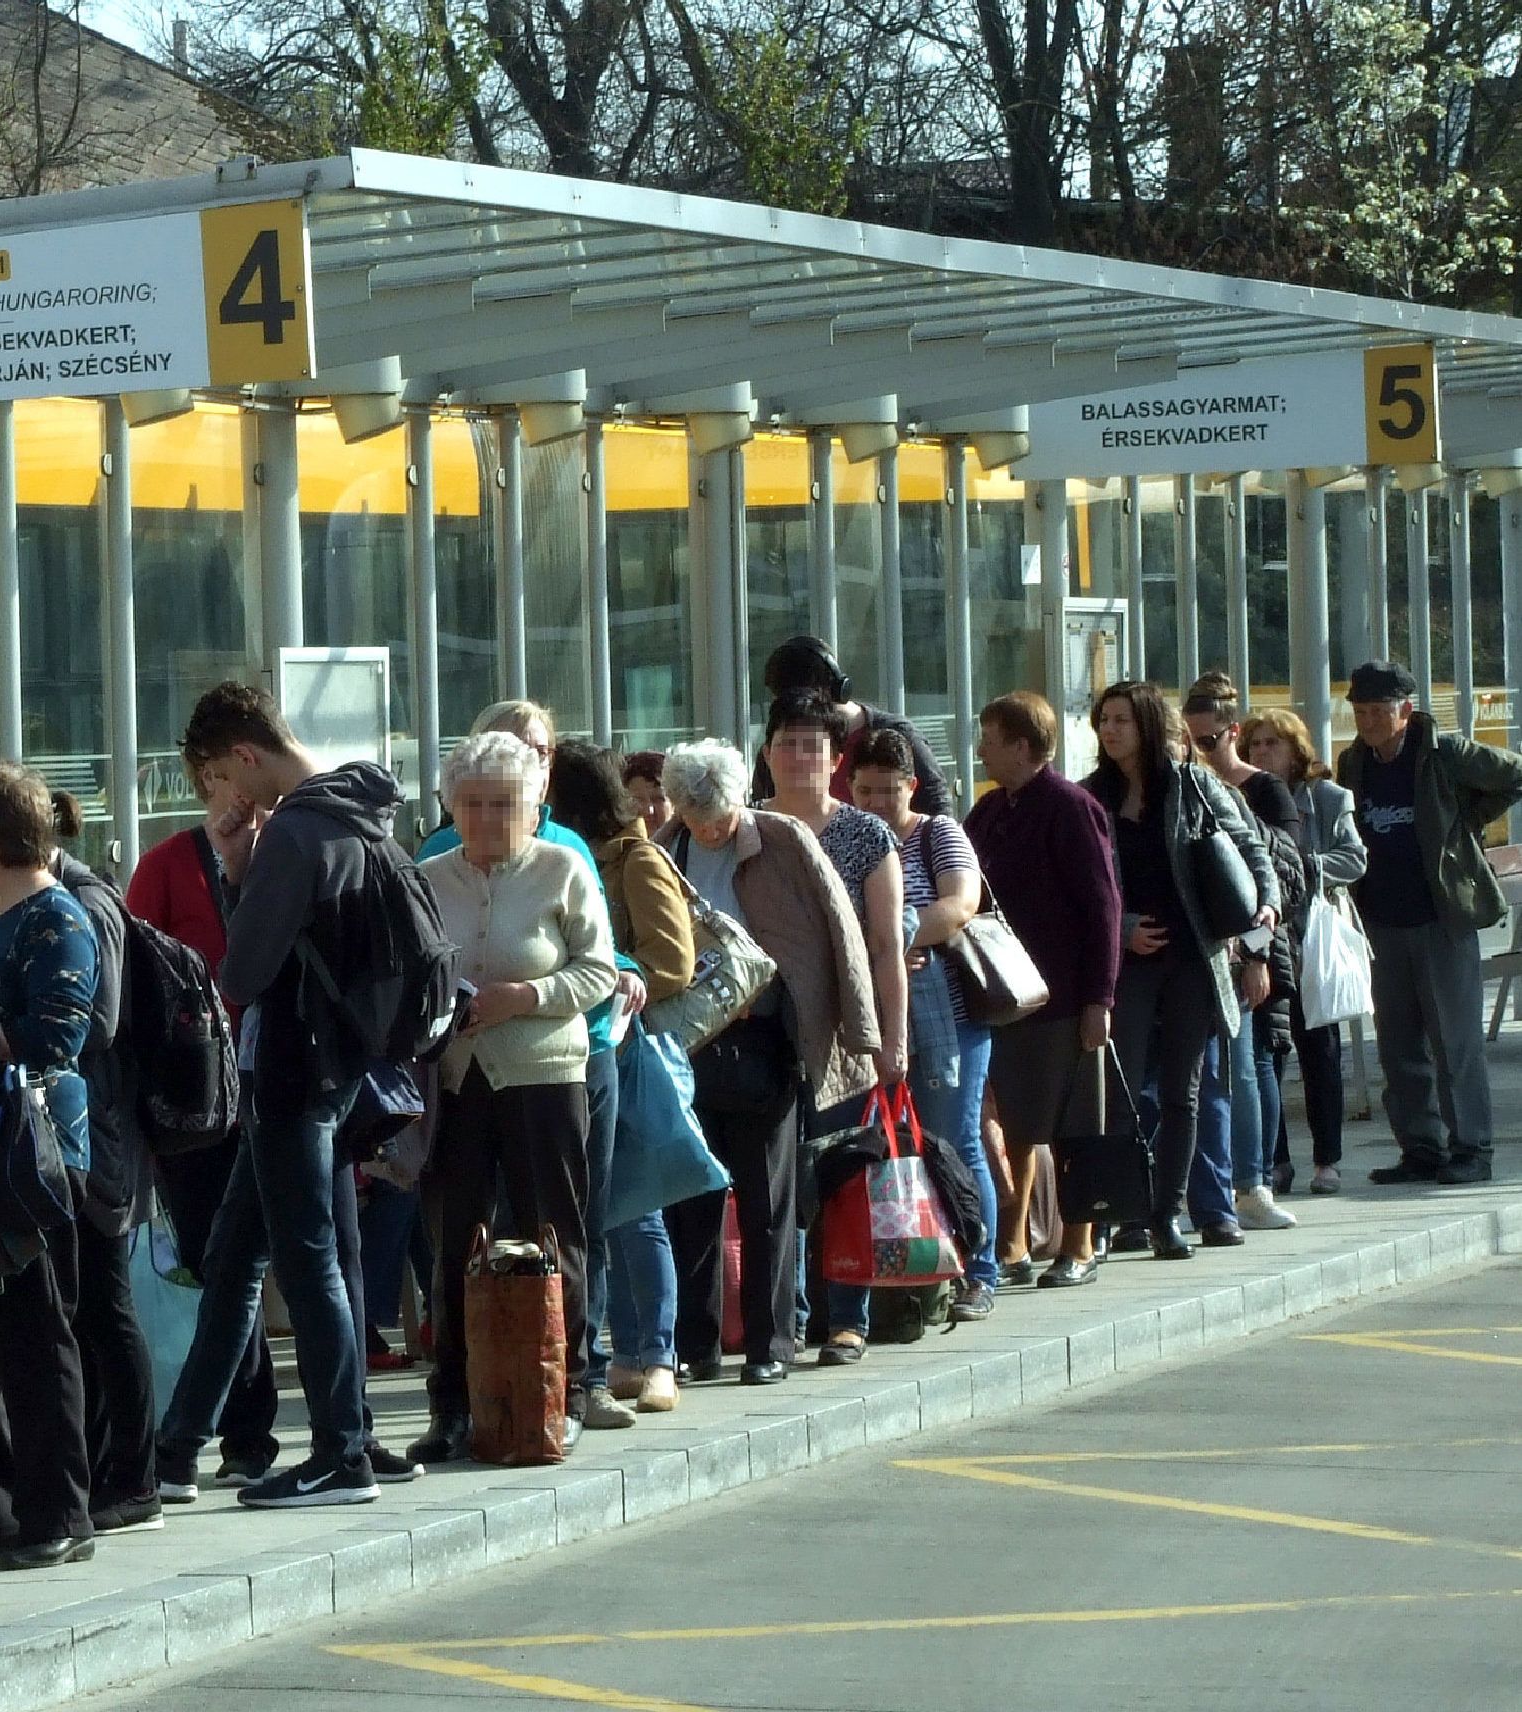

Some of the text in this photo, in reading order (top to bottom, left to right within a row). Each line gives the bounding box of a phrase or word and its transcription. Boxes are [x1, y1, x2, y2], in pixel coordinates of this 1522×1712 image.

[218, 229, 296, 345] 4
[58, 351, 172, 379] SZÉCSÉNY
[1081, 394, 1287, 421] BALASSAGYARMAT;
[1377, 364, 1427, 441] 5
[1101, 423, 1269, 449] ÉRSEKVADKERT
